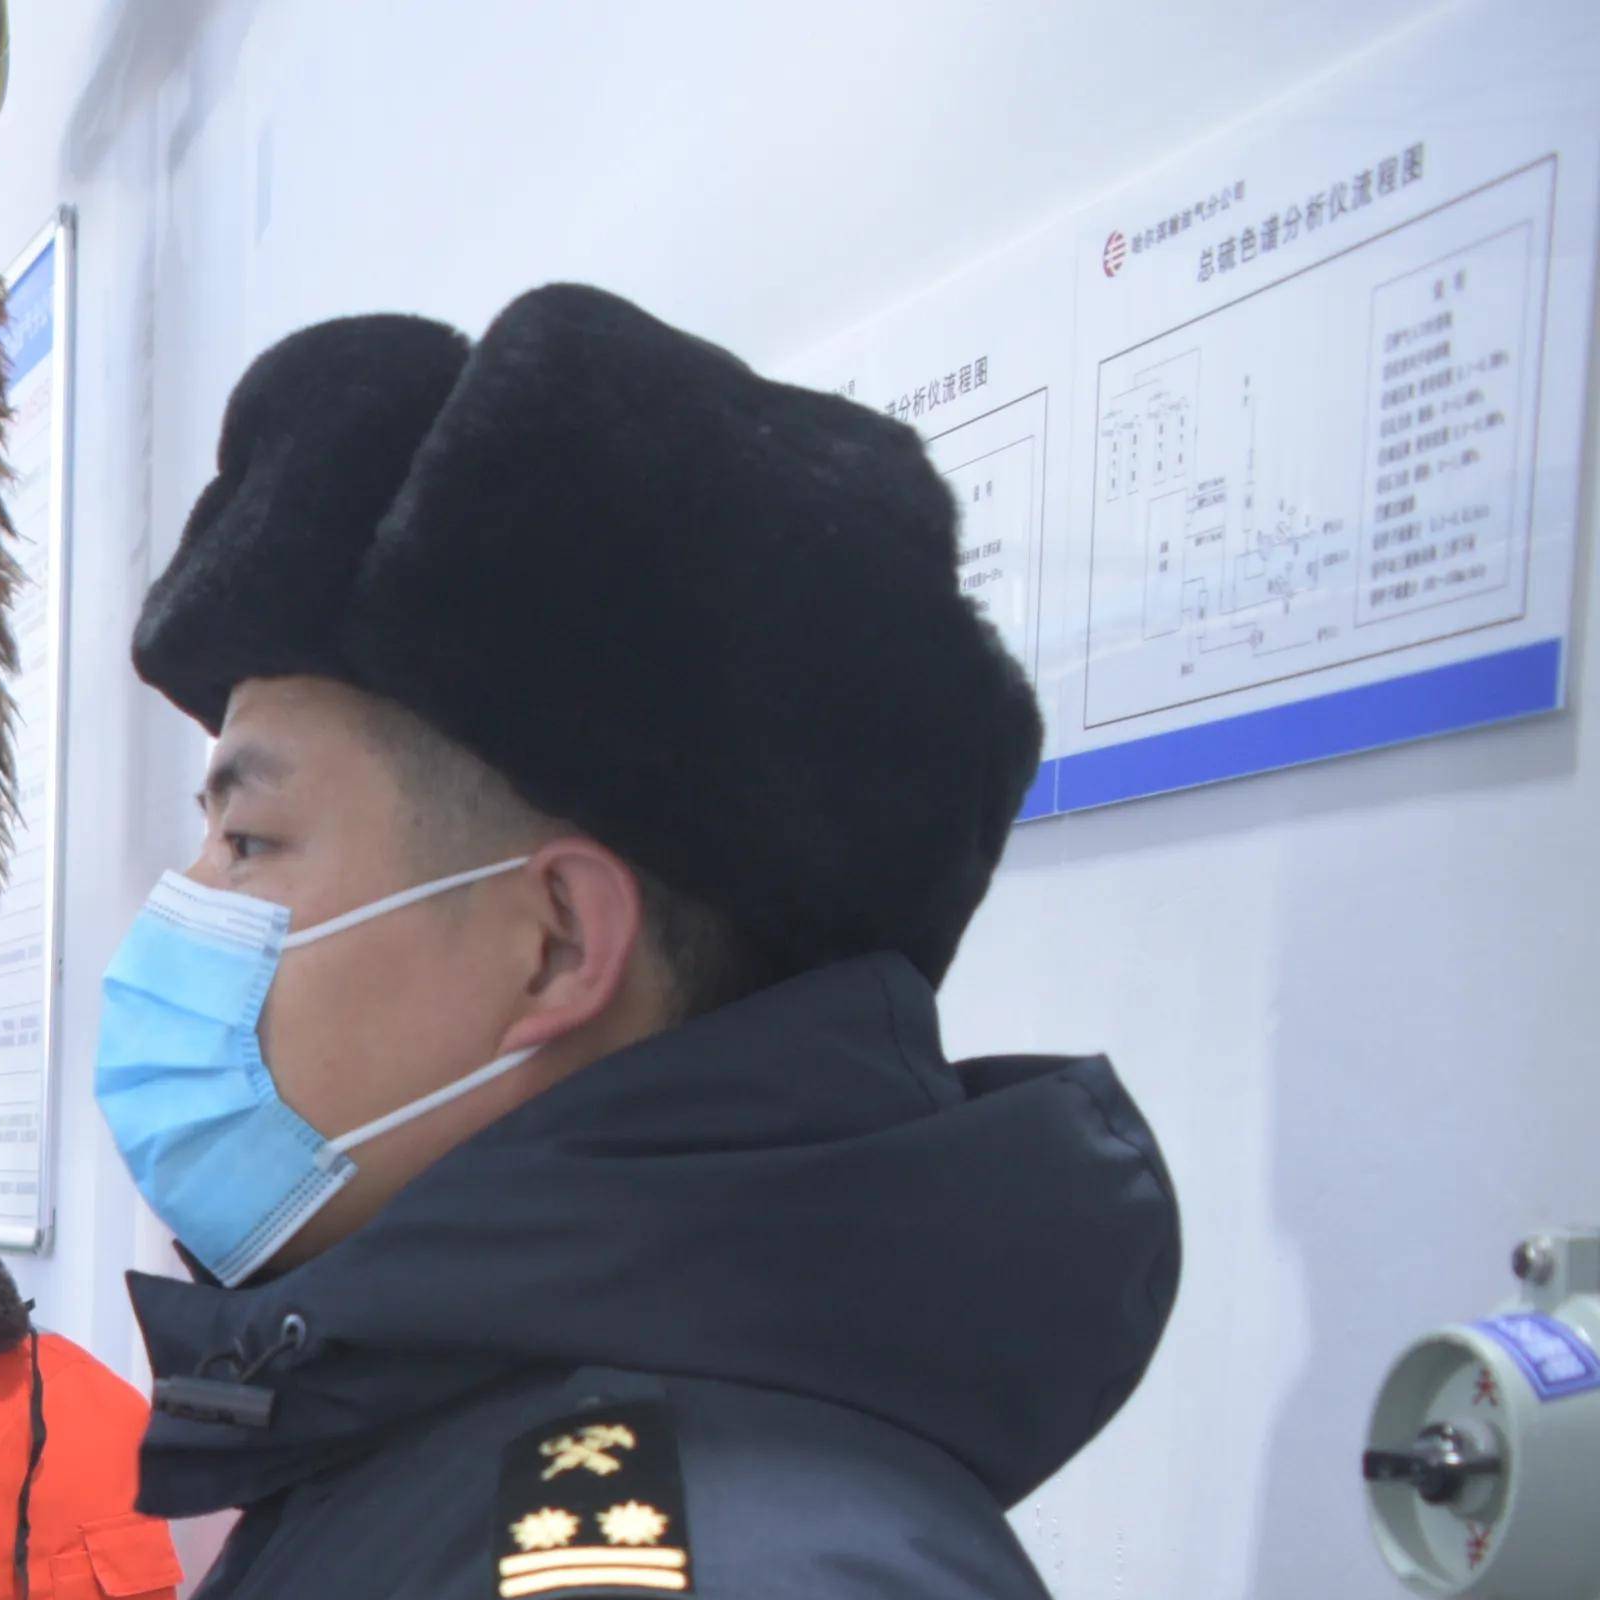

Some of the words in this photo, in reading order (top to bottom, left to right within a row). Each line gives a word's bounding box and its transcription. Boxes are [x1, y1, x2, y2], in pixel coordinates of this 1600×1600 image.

[1197, 141, 1425, 282] 总硫色谱分析仪流程图
